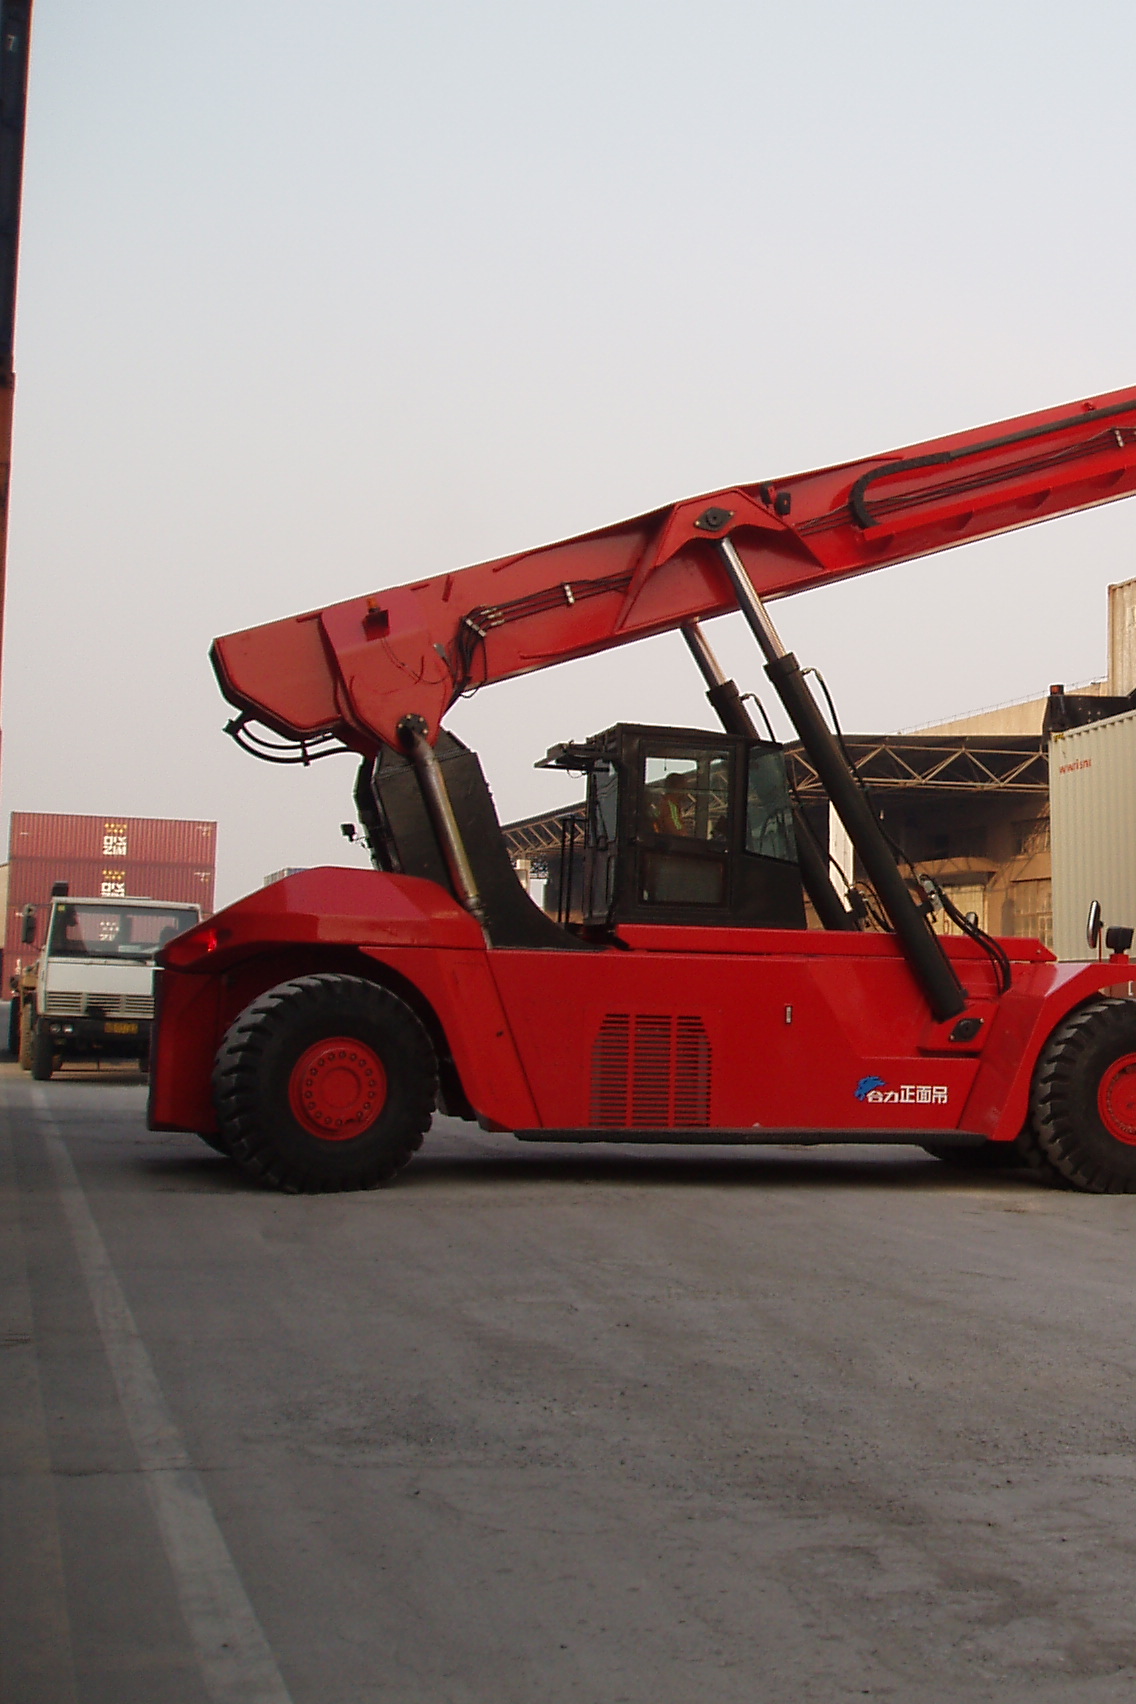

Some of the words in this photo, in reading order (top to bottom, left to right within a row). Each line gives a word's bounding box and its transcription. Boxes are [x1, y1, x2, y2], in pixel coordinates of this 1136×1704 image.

[866, 1085, 948, 1104] 合力正面吊
